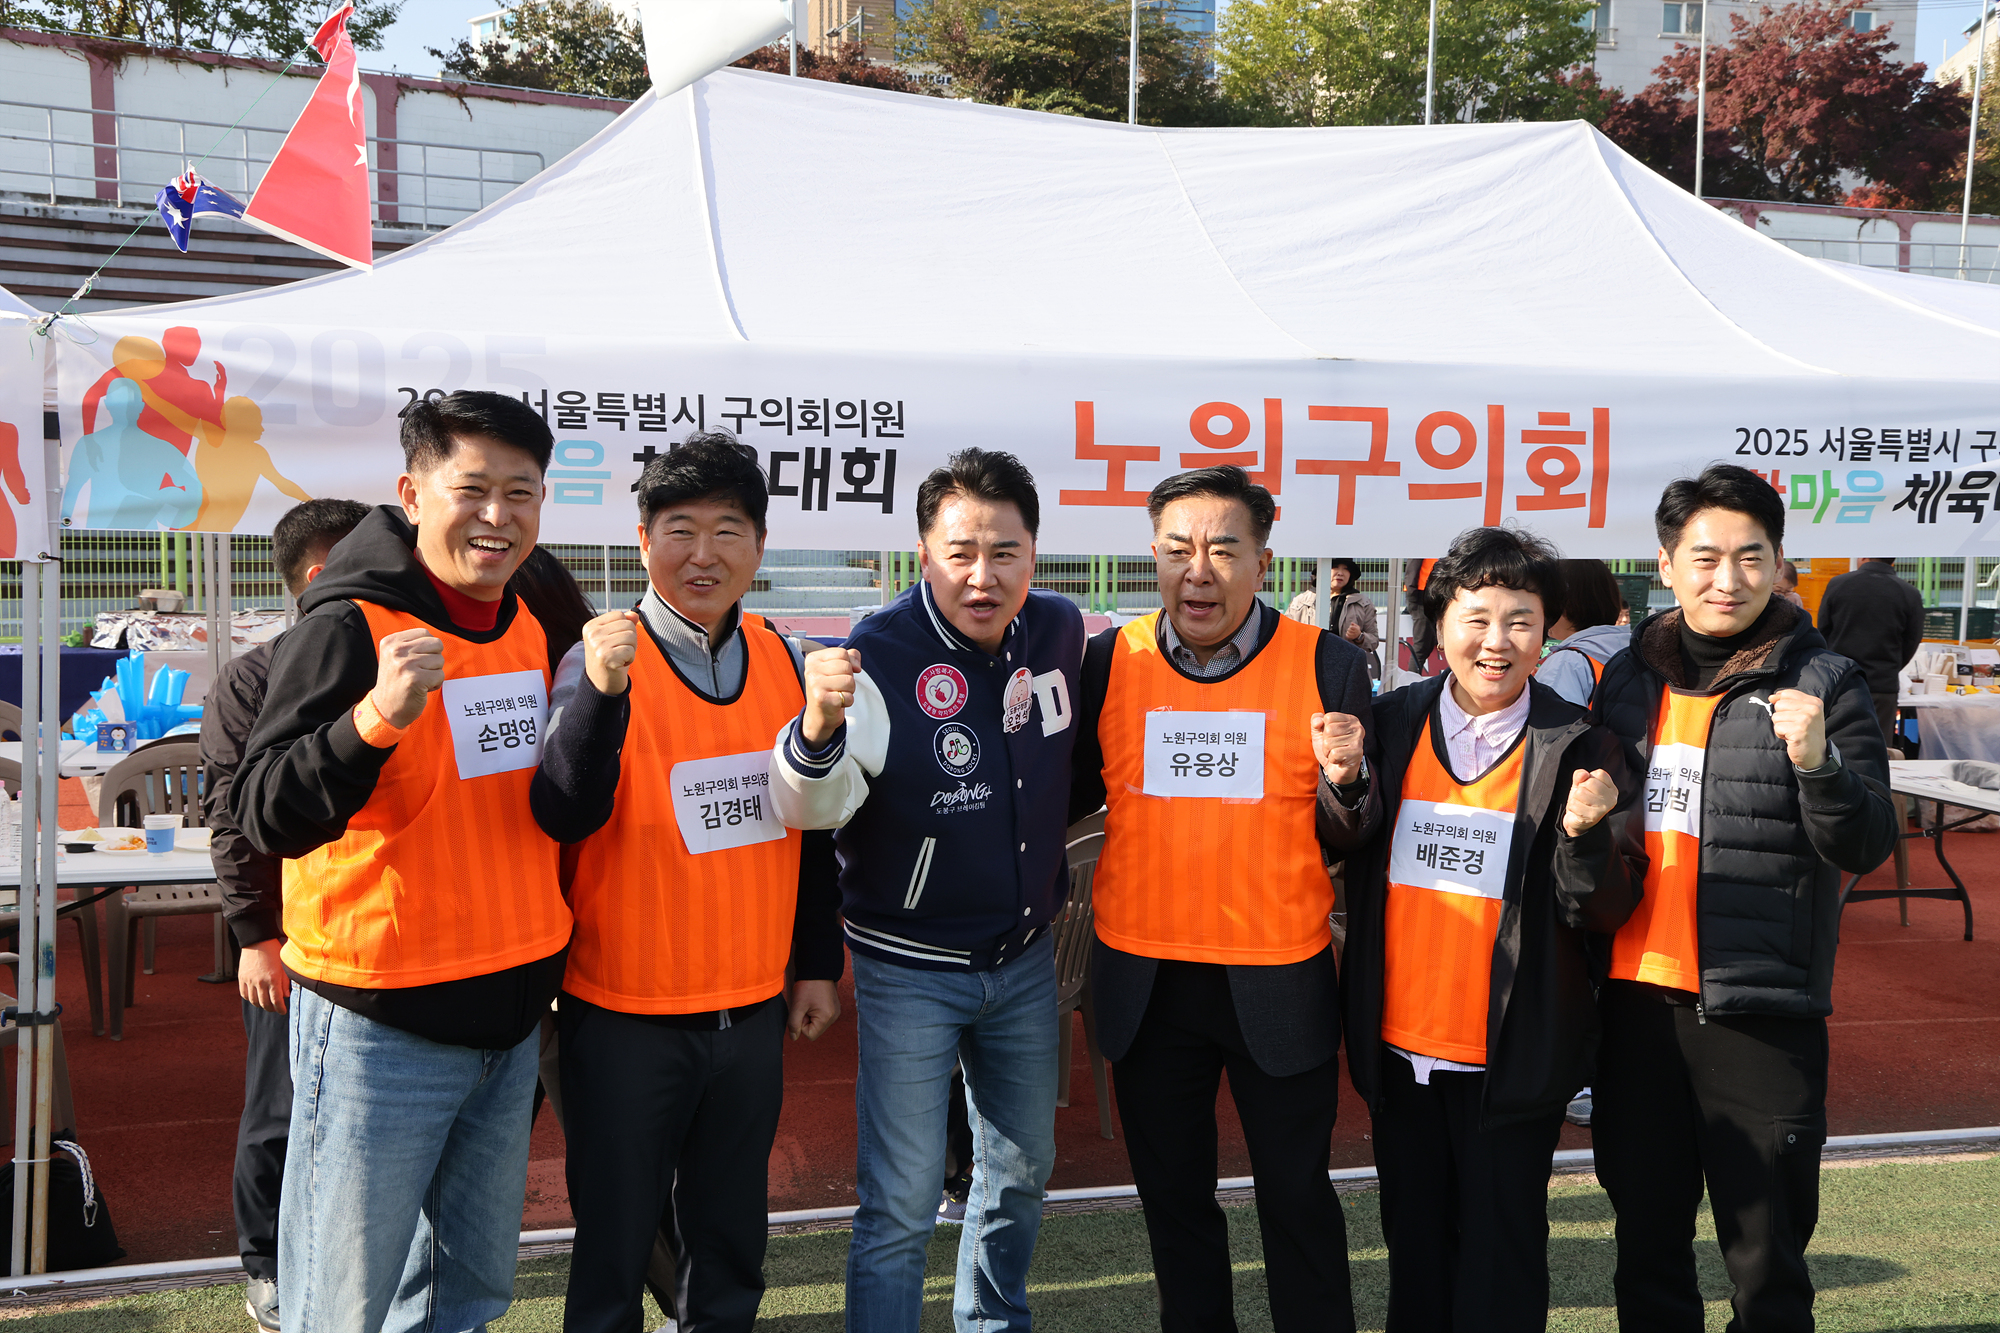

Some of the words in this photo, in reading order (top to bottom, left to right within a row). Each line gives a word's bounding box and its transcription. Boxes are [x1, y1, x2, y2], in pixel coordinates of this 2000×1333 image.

[720, 395, 906, 439] 구의회의원
[1735, 427, 1809, 456] 2025
[1818, 427, 1961, 463] 서울특별시
[1970, 430, 2000, 463] 구
[1059, 398, 1610, 529] 노원구의회
[1892, 470, 2000, 524] 체육
[463, 697, 517, 717] 노원구의회
[517, 693, 539, 709] 의원
[1033, 668, 1072, 738] D
[477, 716, 537, 753] 손명영
[941, 725, 960, 736] SEOUL
[1162, 731, 1221, 746] 노원구의회
[1223, 731, 1248, 746] 의원
[942, 760, 966, 775] DOBONG
[965, 752, 978, 773] SOCKS
[1169, 751, 1239, 778] 유웅상
[1680, 767, 1702, 785] 의원
[683, 776, 739, 798] 노원구의회
[741, 771, 770, 789] 부의장
[699, 794, 763, 830] 김경태
[935, 805, 956, 815] 도봉구
[1647, 787, 1690, 813] 김범
[1411, 821, 1469, 840] 노원구의회
[1471, 829, 1497, 845] 의원
[1415, 843, 1485, 875] 배준경
